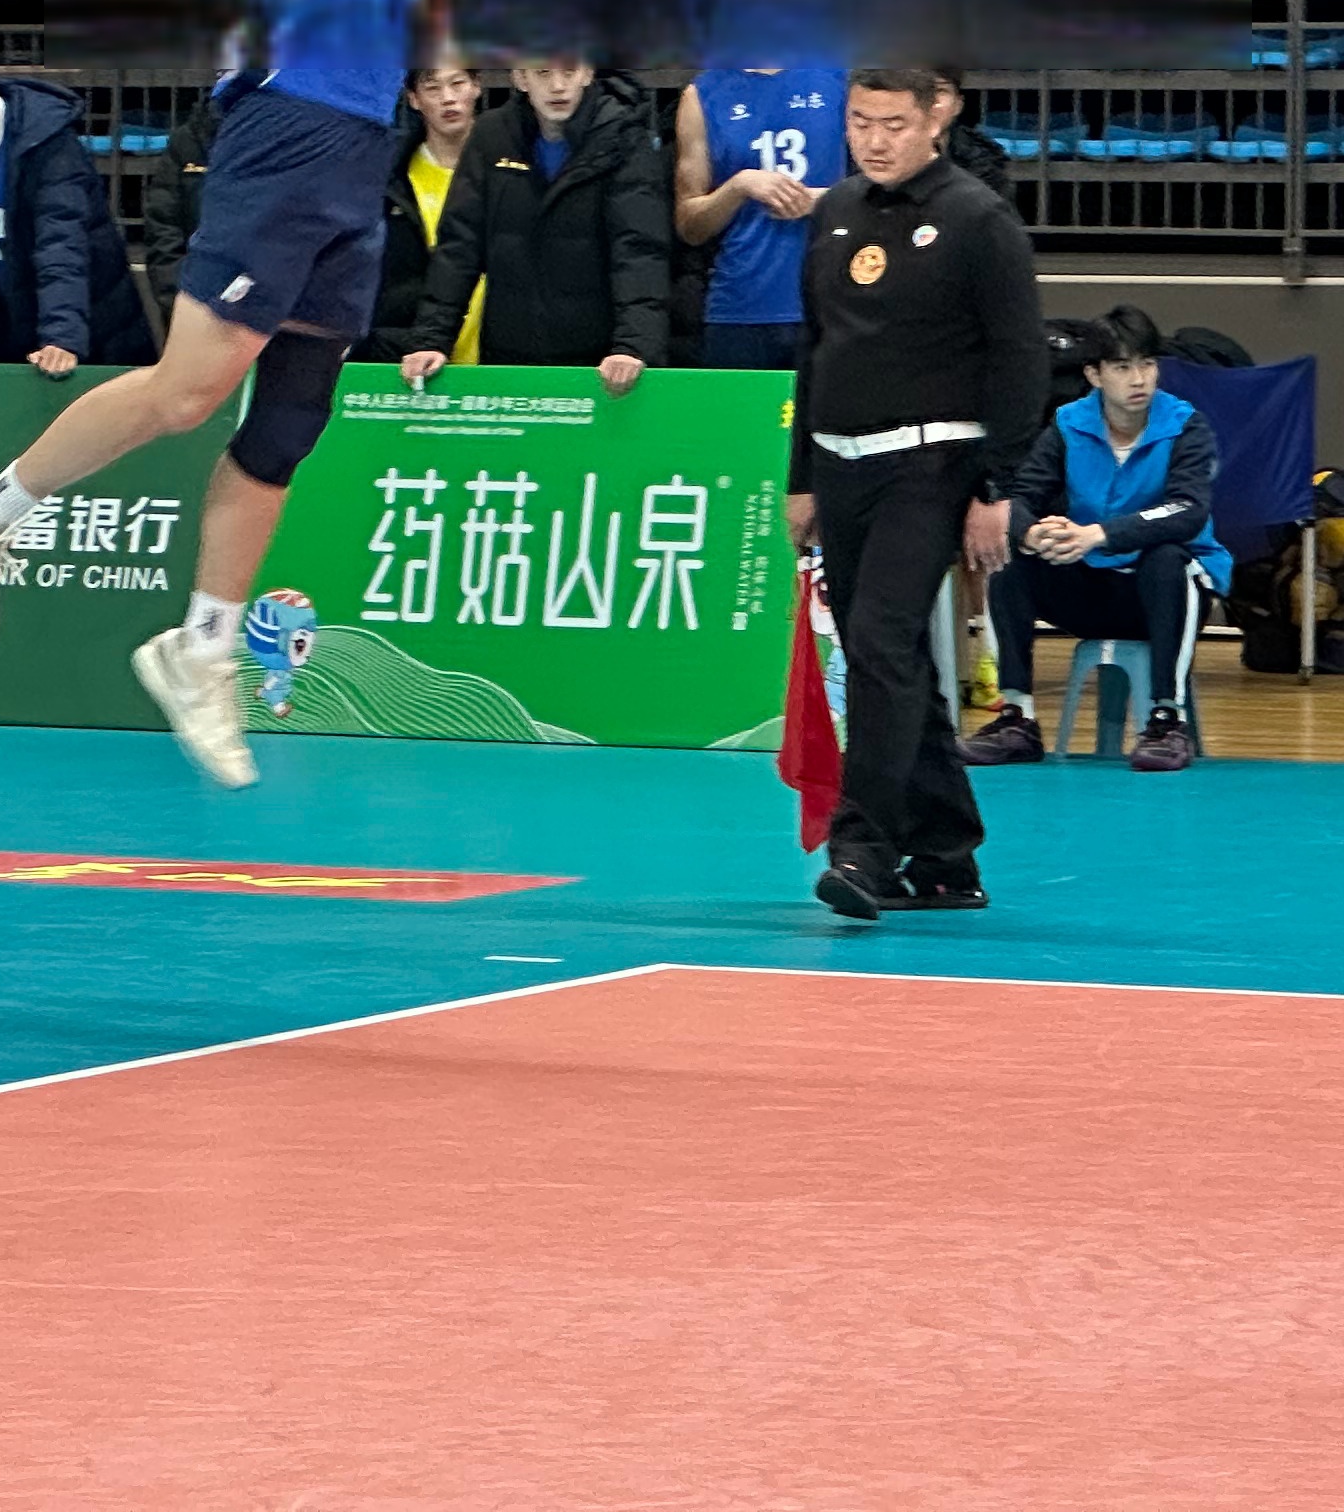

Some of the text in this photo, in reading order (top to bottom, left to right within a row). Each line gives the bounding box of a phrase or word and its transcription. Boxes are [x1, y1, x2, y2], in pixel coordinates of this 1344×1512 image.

[750, 128, 808, 182] 13
[360, 467, 709, 631] 药菇山泉
[35, 563, 76, 588] OF
[82, 565, 169, 591] CHINA
